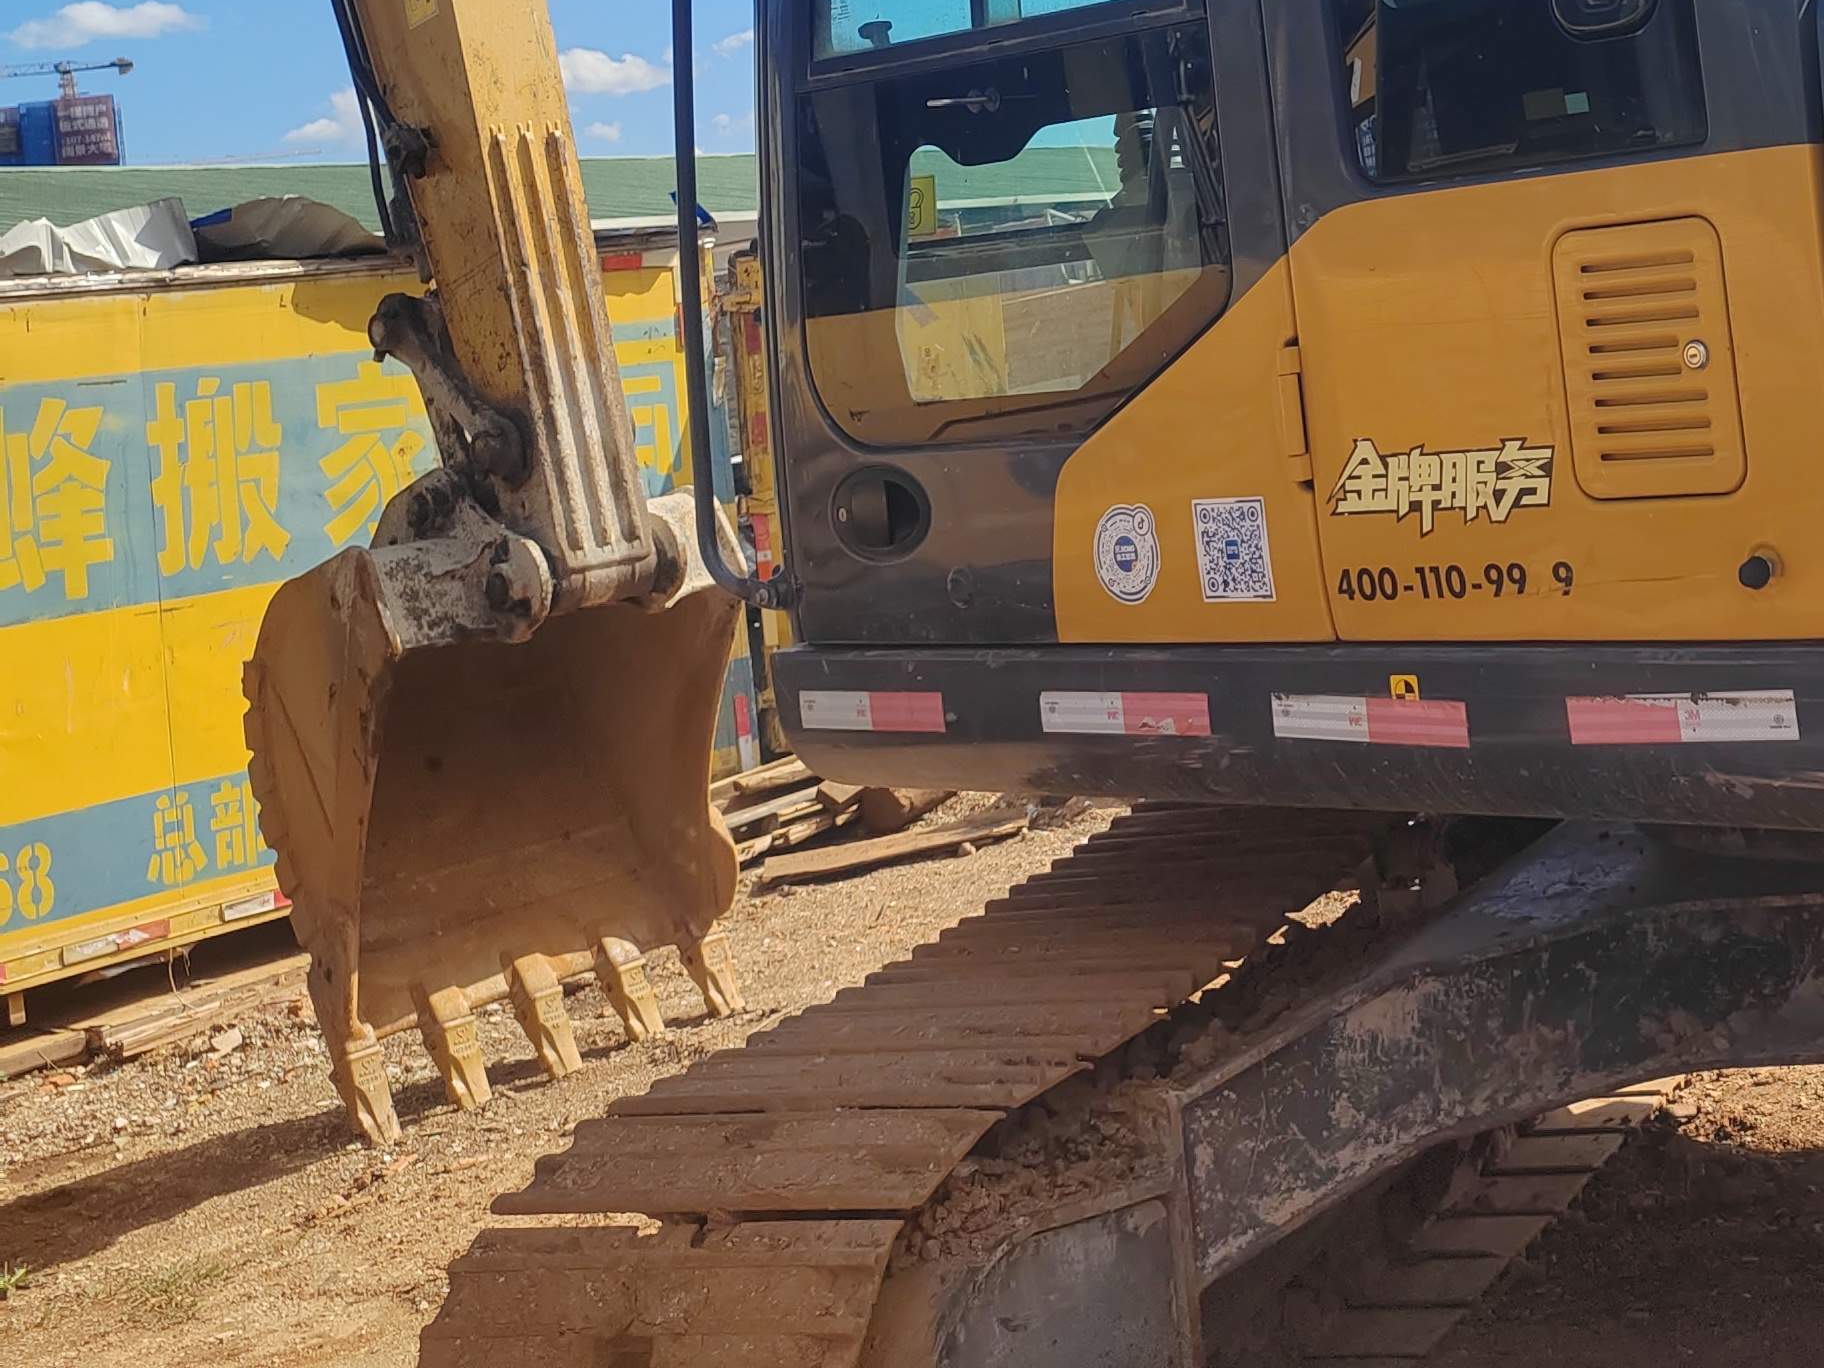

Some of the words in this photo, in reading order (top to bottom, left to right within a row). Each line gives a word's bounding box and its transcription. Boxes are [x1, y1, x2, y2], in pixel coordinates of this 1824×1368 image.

[1327, 437, 1555, 538] 金牌服务
[147, 780, 262, 885] 总部
